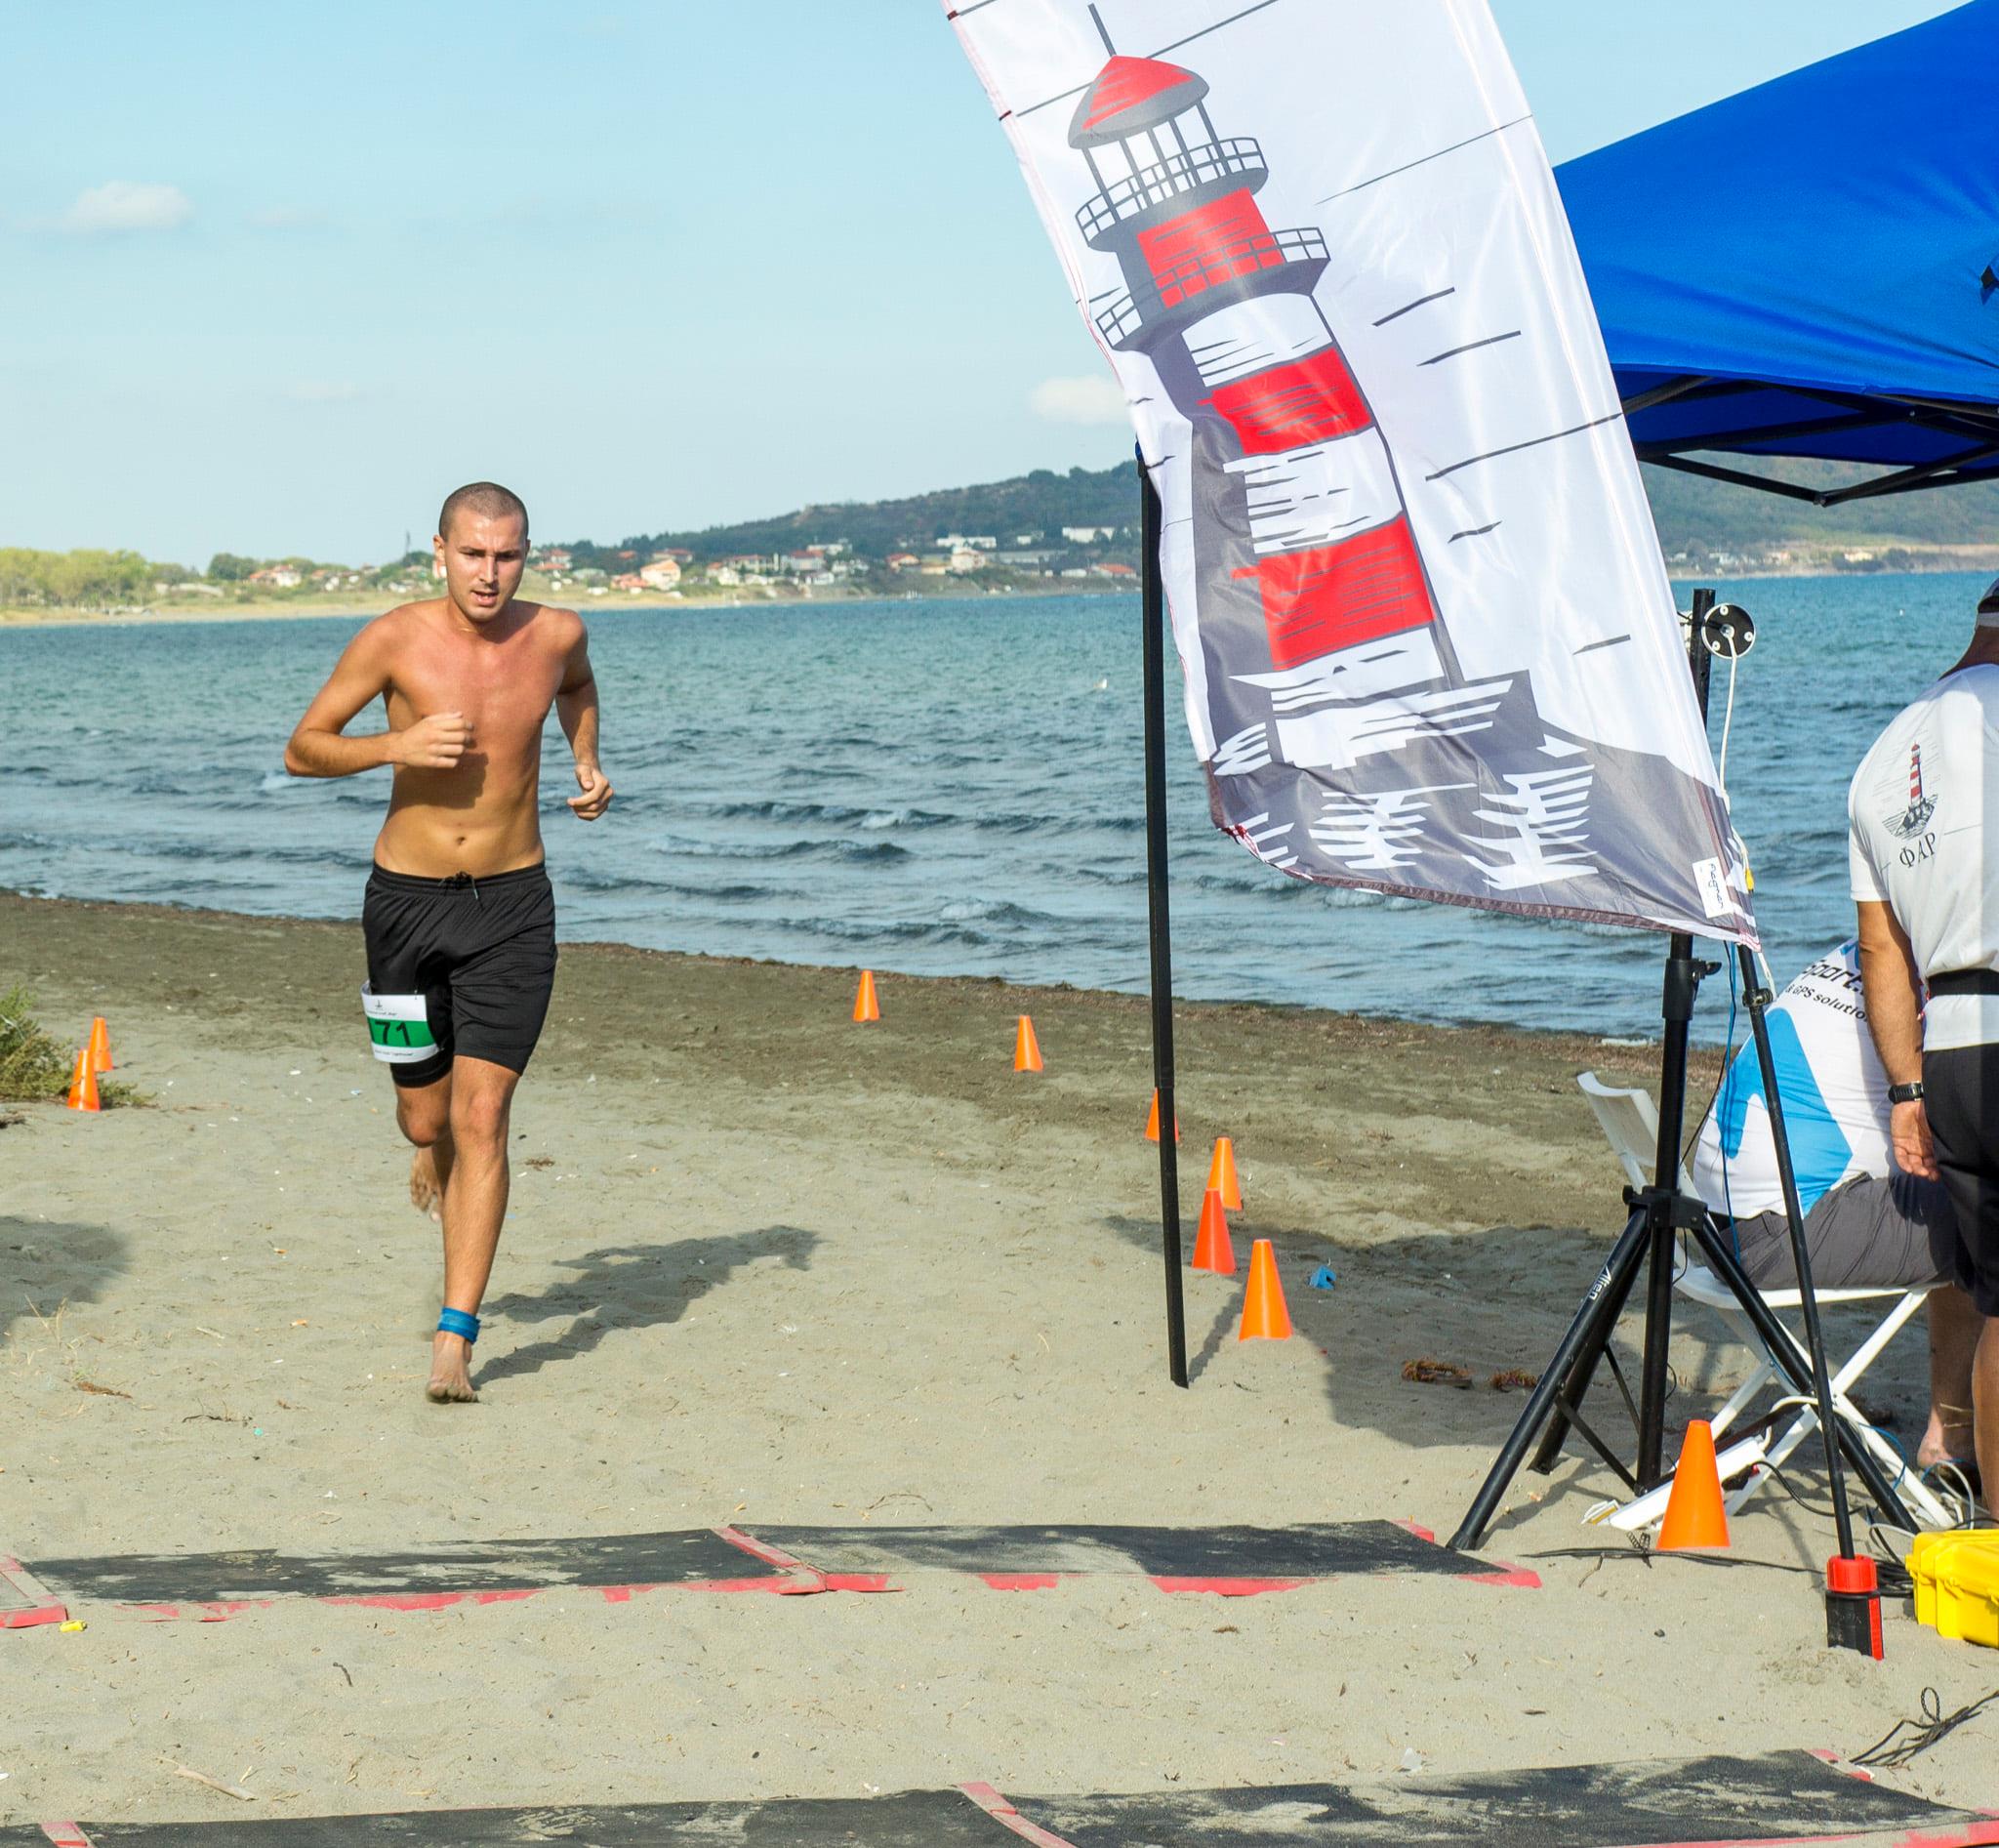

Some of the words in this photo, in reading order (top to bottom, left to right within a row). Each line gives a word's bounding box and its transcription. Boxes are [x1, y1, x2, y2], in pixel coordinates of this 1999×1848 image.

[1899, 832, 1936, 868] ФАР
[1792, 984, 1815, 999] GPS
[1813, 994, 1868, 1023] solutio
